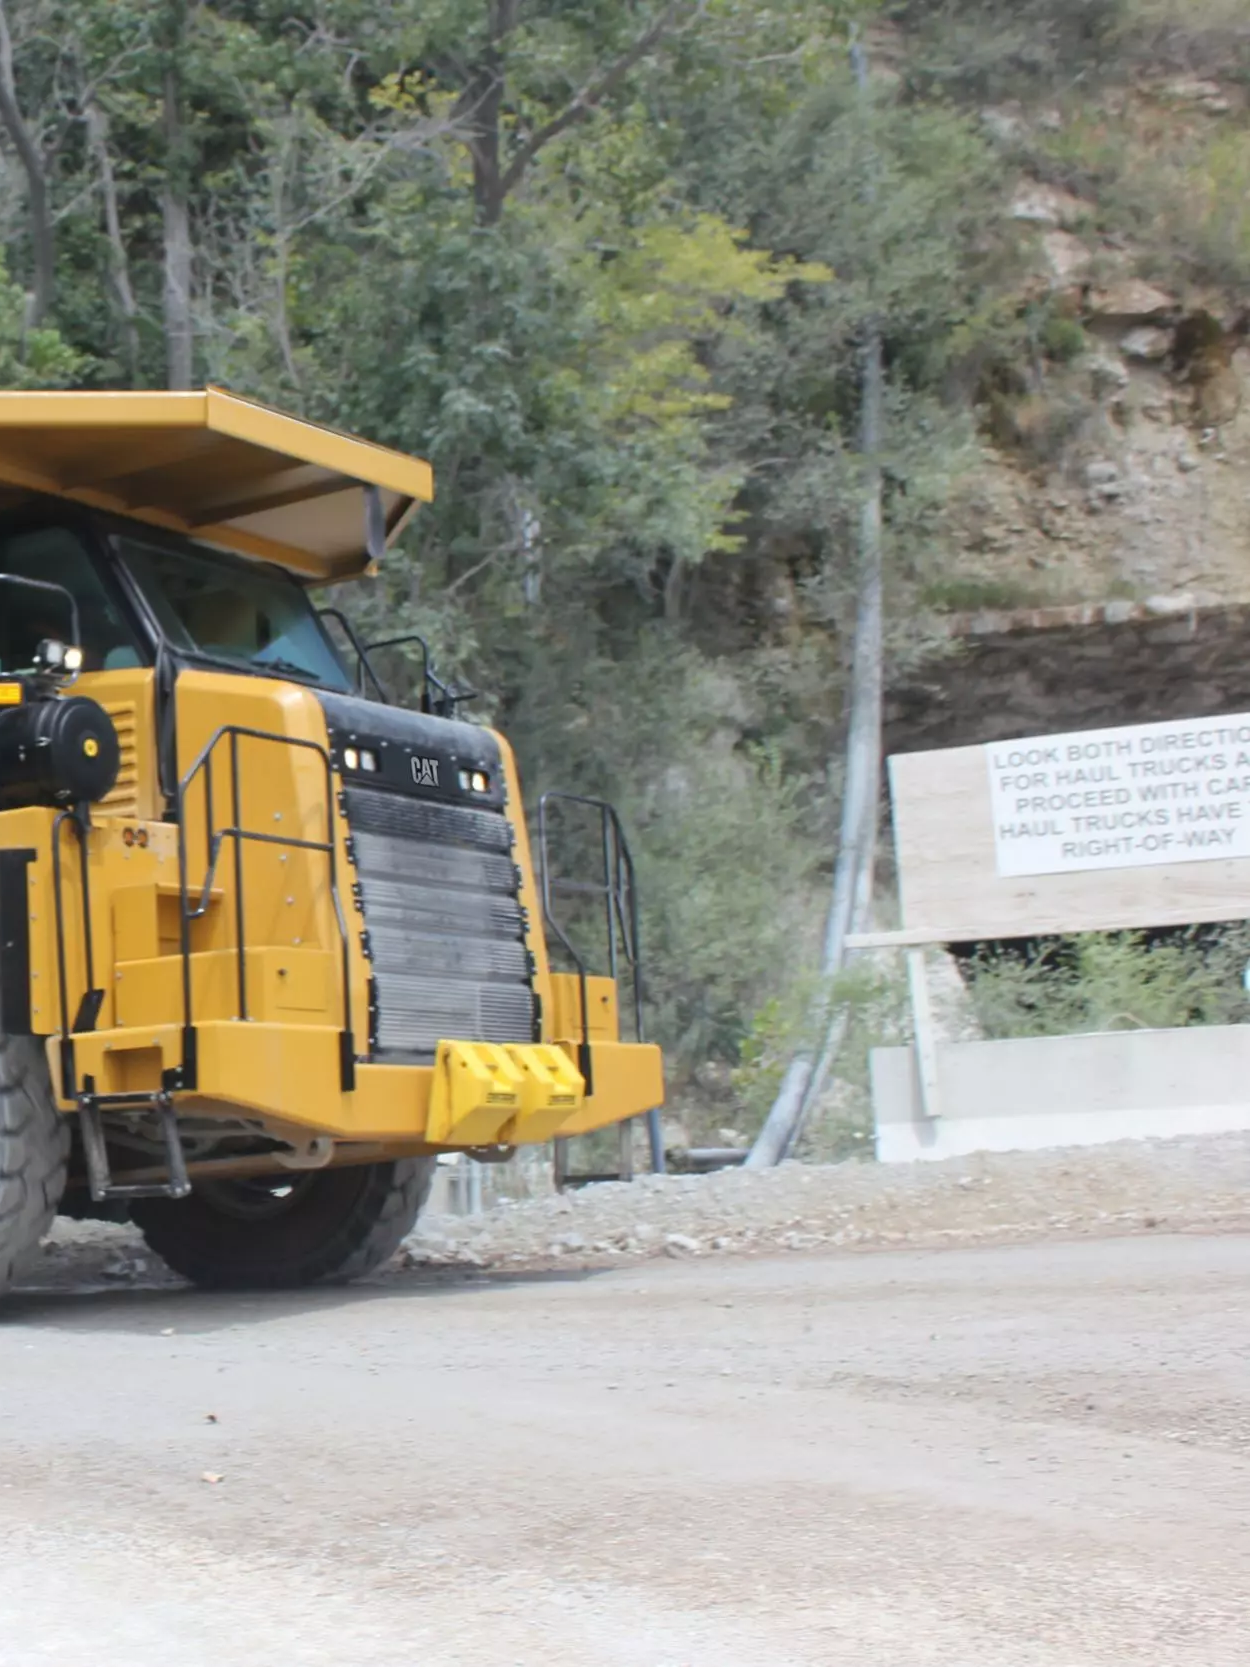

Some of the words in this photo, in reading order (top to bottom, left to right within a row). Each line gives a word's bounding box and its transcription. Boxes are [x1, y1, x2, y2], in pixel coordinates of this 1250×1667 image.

[994, 747, 1060, 769] LOOK
[1066, 739, 1132, 761] BOTH
[410, 755, 440, 787] CAT
[1000, 772, 1049, 792] FOR
[1055, 765, 1120, 786] HAUL
[1128, 753, 1227, 778] TRUCKS
[1015, 788, 1131, 813] PROCEED
[1137, 781, 1199, 802] WITH
[1000, 819, 1064, 840] HAUL
[1070, 808, 1170, 834] TRUCKS
[1177, 801, 1243, 823] HAVE
[1061, 828, 1236, 859] RIGHT-OF-WAY
